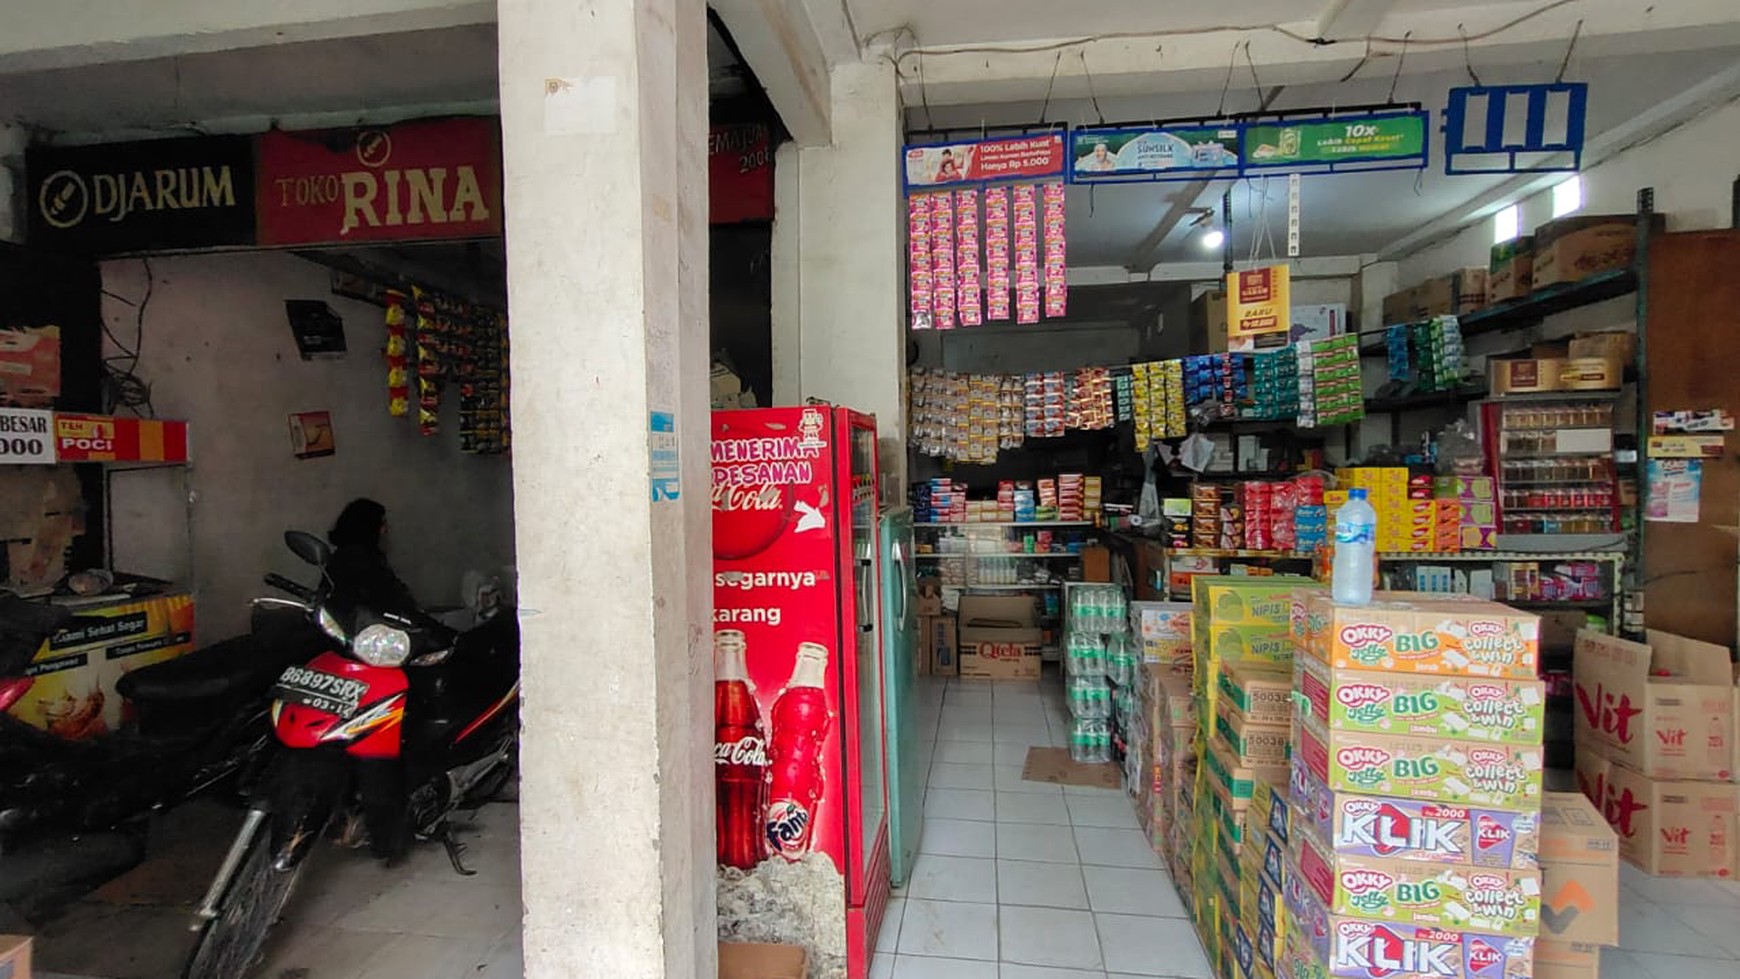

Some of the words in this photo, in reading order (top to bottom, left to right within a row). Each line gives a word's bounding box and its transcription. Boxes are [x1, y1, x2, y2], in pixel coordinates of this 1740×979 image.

[980, 144, 1003, 153] 100%
[1005, 141, 1028, 151] Lebih
[981, 161, 1007, 172] Hanya
[1009, 159, 1021, 169] Rp
[94, 165, 236, 222] DJARUM
[275, 174, 339, 208] TOKO
[339, 165, 490, 234] RINA
[0, 414, 47, 433] BESAR
[61, 422, 83, 430] TEH
[63, 438, 112, 450] POCI
[712, 461, 812, 487] PESANAN
[1252, 603, 1280, 617] NIPIS
[117, 619, 145, 633] Segar
[1340, 624, 1392, 647] OKKY
[1395, 631, 1439, 652] BIG
[1252, 642, 1280, 656] NIPIS
[1337, 685, 1390, 707] OKKY
[1393, 692, 1438, 713] BIG
[1576, 682, 1643, 744] Vit
[1656, 729, 1687, 745] Vit
[1338, 747, 1390, 770] OKKY
[1393, 757, 1438, 778] BIG
[1343, 800, 1380, 817] OKKY
[1435, 808, 1465, 818] 2000
[1341, 813, 1466, 853] KLIK
[1478, 829, 1511, 839] KLIK
[1661, 827, 1690, 844] Vit
[1341, 870, 1393, 893] OKKY
[1396, 880, 1440, 902] BIG
[1338, 922, 1374, 938] OKKY
[1428, 930, 1459, 942] 2000
[1337, 935, 1457, 977] KLIK
[1469, 951, 1501, 962] KLIK
